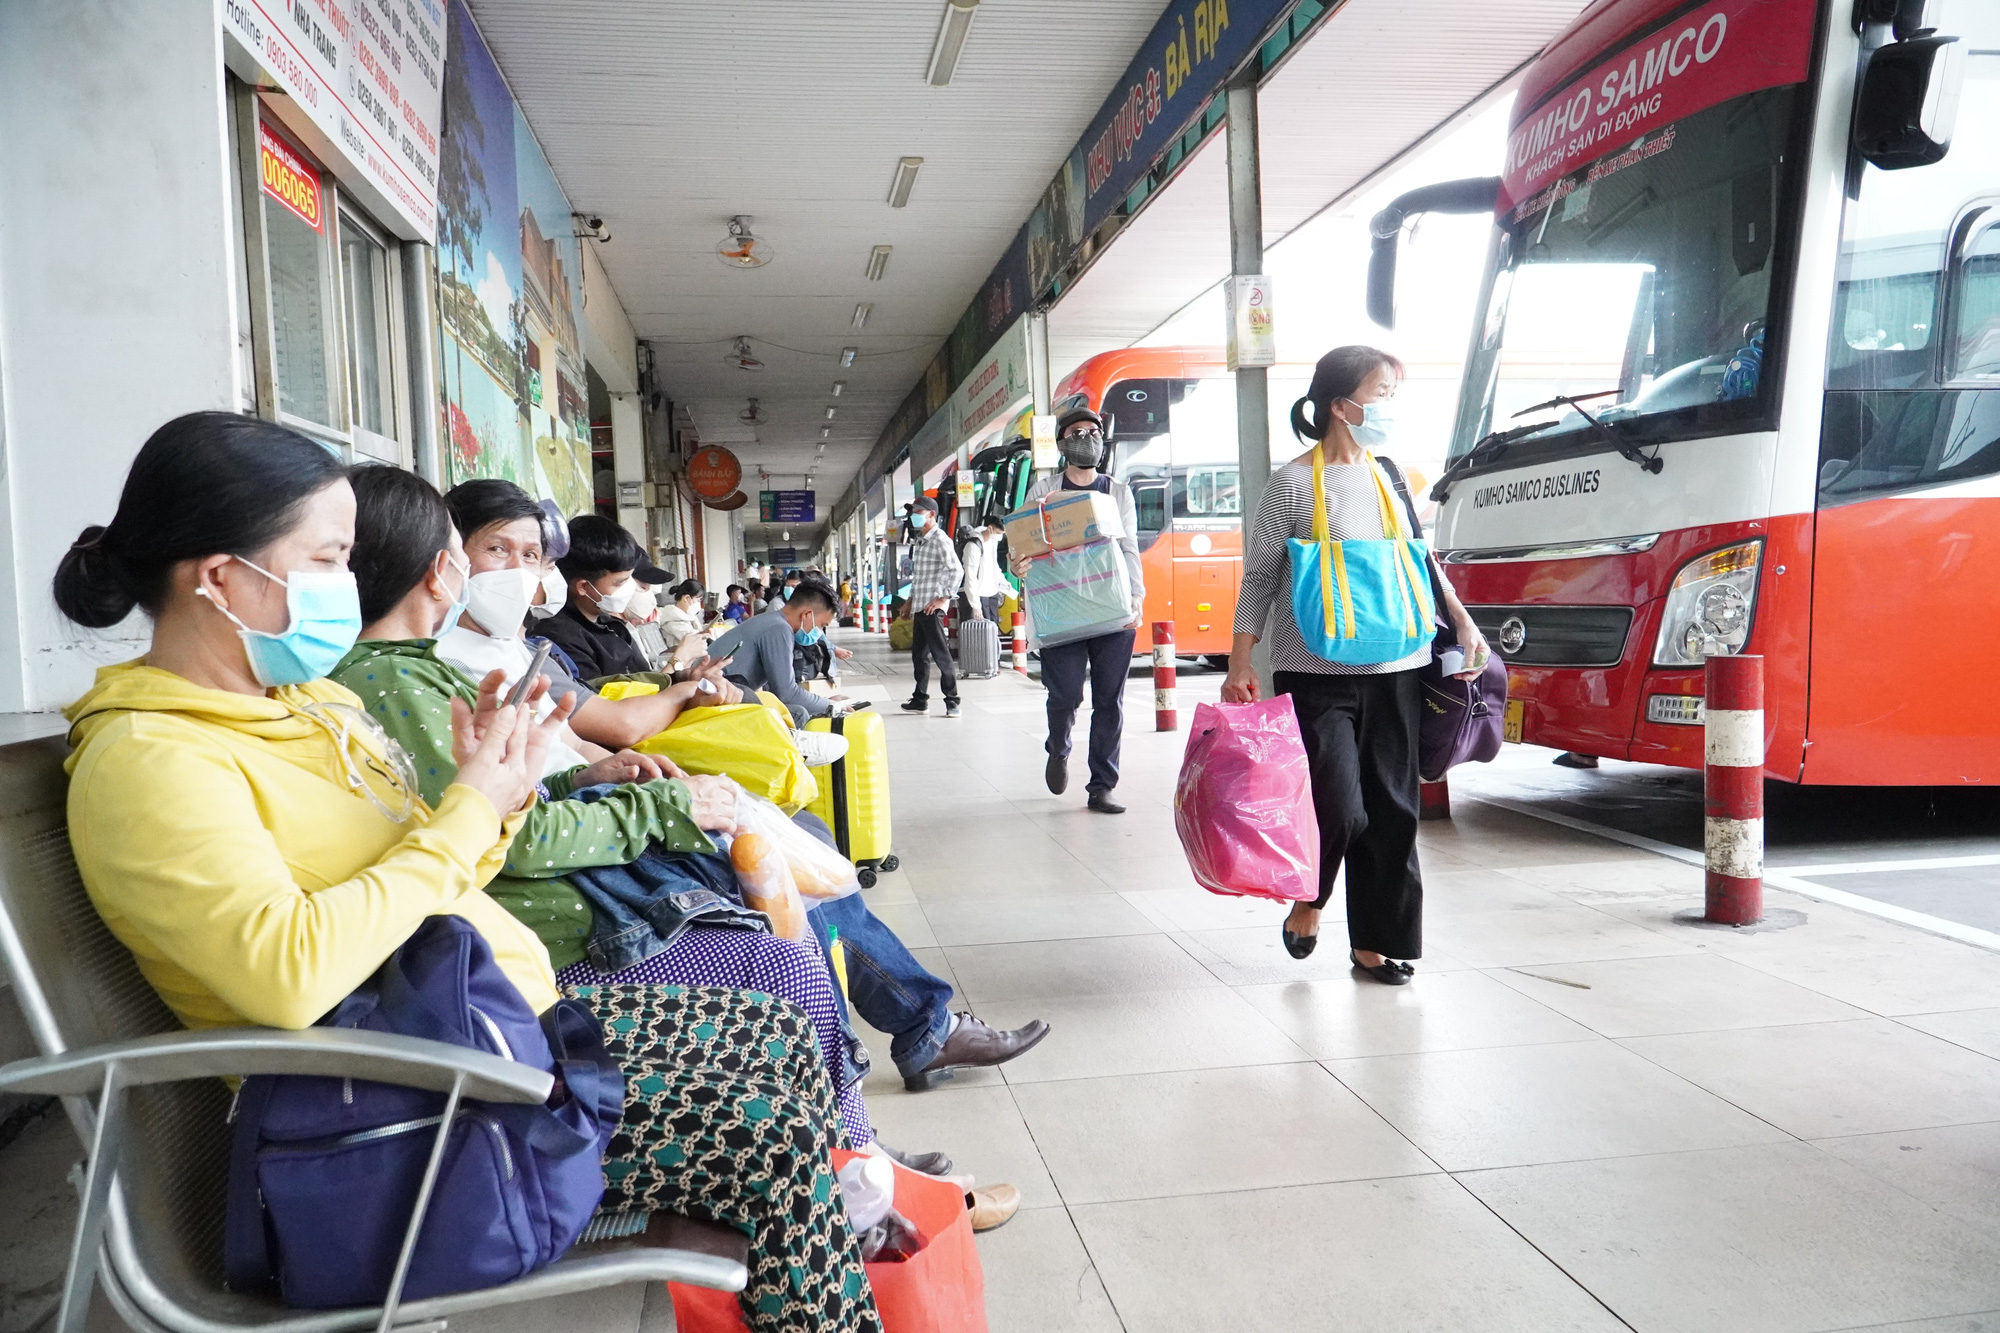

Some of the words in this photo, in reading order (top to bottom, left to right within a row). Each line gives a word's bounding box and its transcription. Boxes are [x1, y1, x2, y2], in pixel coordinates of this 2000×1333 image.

[227, 0, 263, 50] Hotline:
[266, 35, 286, 74] 0903
[288, 60, 302, 92] 580
[304, 77, 317, 108] 000
[294, 0, 310, 39] NHA
[313, 21, 336, 70] TRANG
[359, 40, 374, 77] 0262
[357, 78, 372, 114] 0258
[1087, 123, 1113, 200] KHU
[1114, 82, 1144, 162] VỰC
[1146, 67, 1161, 124] 3:
[1165, 13, 1191, 101] BÀ
[1194, 0, 1229, 65] RỊA
[1502, 87, 1592, 180] KUMHO
[1596, 13, 1727, 116] SAMCO
[340, 114, 366, 161] Website:
[1525, 142, 1570, 185] KHÁCH
[1567, 129, 1595, 157] SẠN
[1597, 118, 1613, 142] DI
[1614, 92, 1662, 131] ĐỘNG
[1603, 156, 1619, 176] XE
[1617, 144, 1645, 172] PHAN
[262, 150, 316, 220] 006065
[1473, 484, 1505, 509] KUMHO
[1505, 478, 1542, 504] SAMCO
[1542, 469, 1601, 499] BUSLINES
